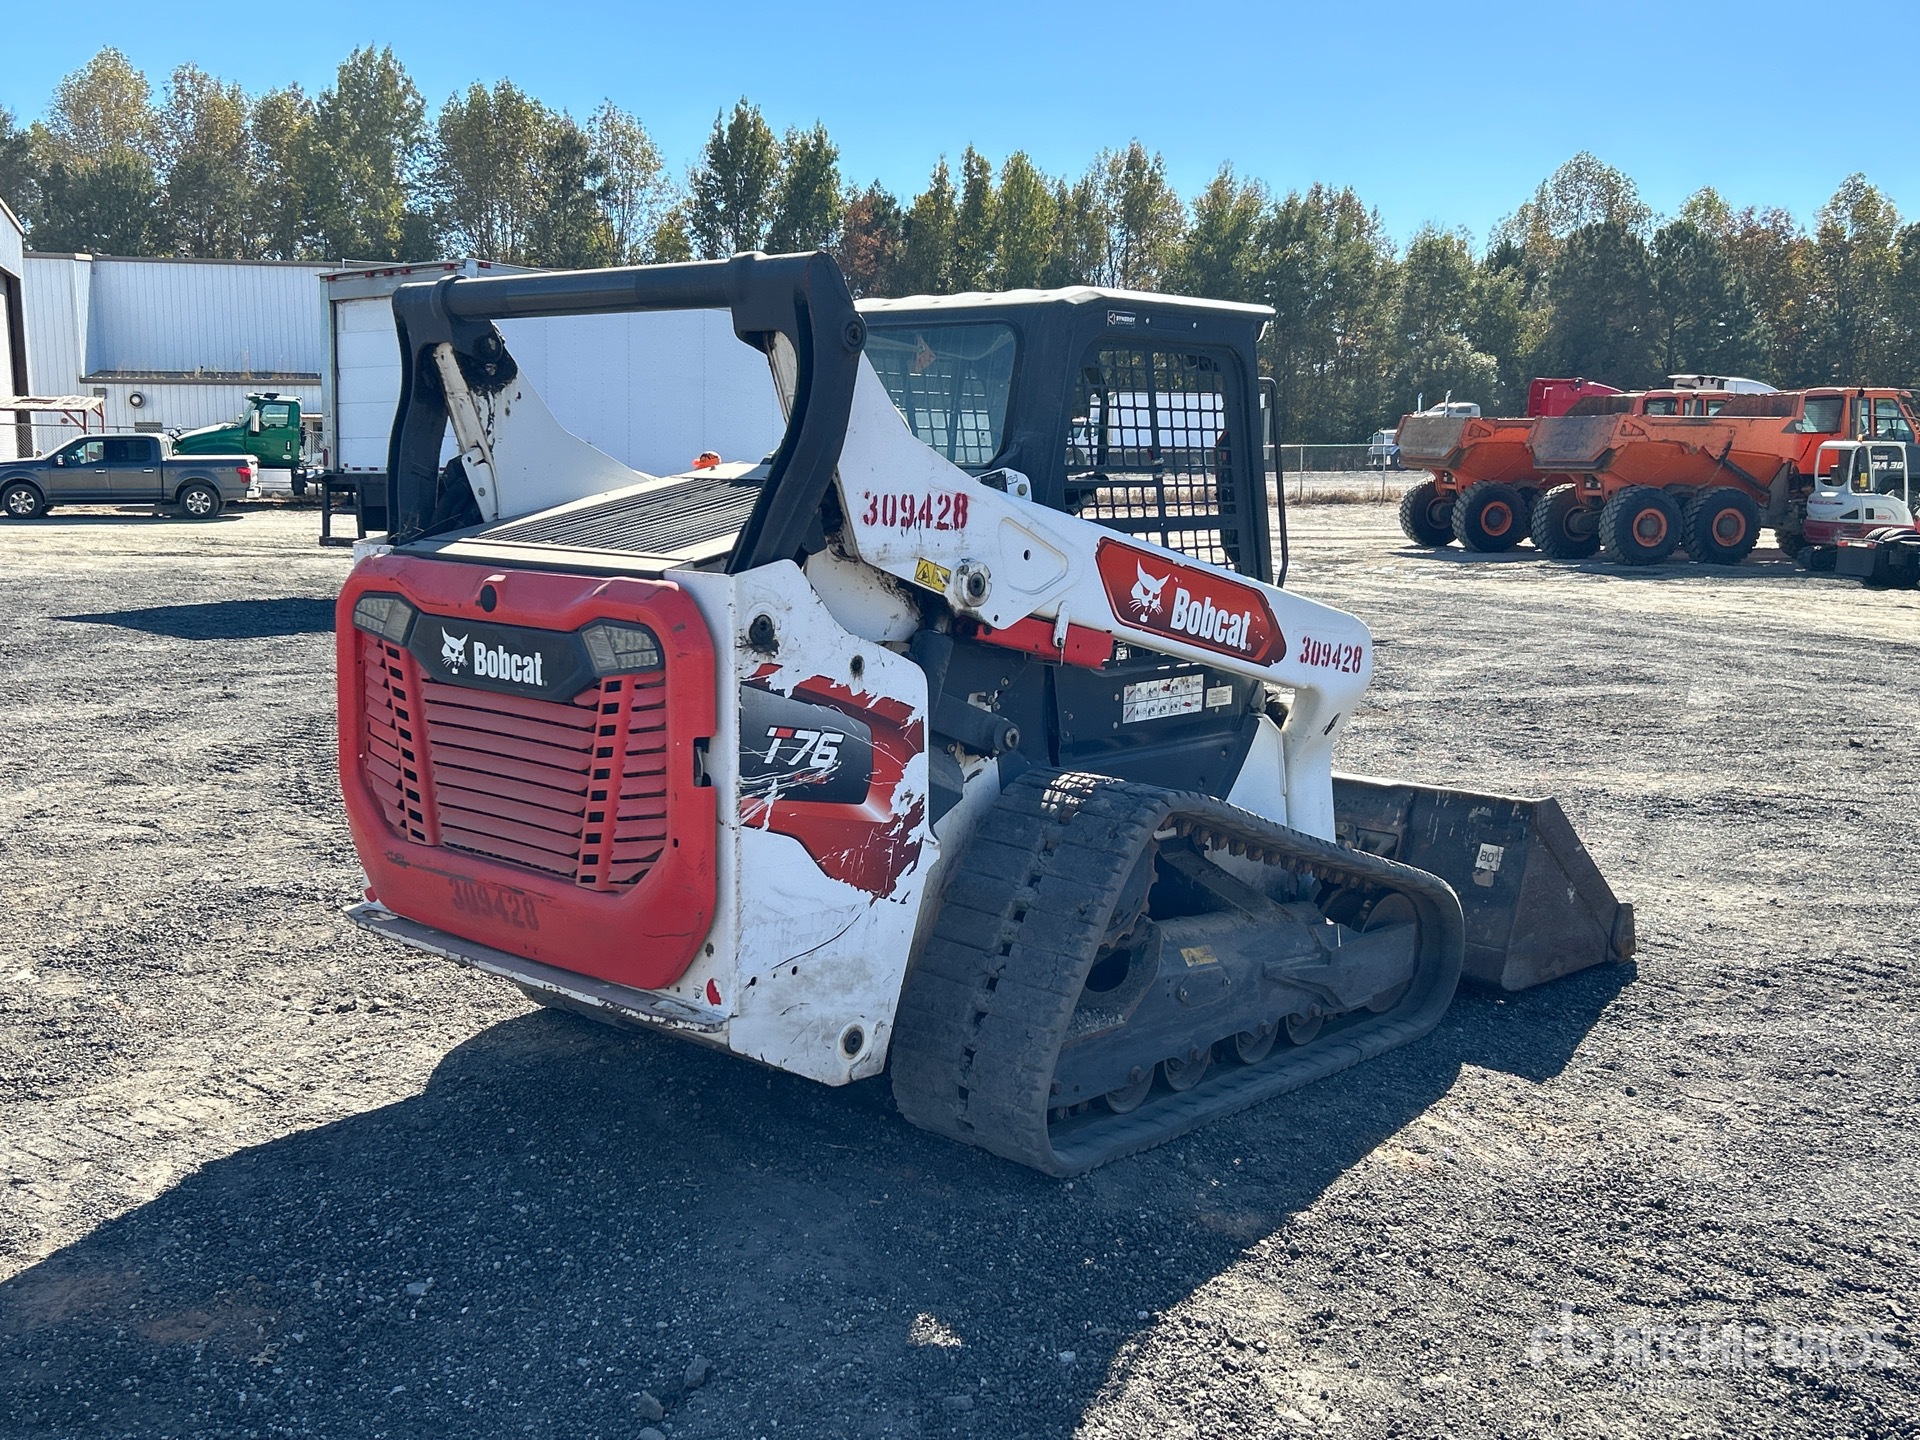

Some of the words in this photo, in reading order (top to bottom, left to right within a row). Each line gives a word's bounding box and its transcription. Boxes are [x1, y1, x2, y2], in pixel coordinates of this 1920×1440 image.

[863, 490, 968, 530] 309428
[1170, 587, 1251, 650] Bobcat
[473, 641, 543, 686] Bobcat
[1299, 635, 1363, 674] 309428
[763, 726, 845, 768] T76
[449, 876, 540, 932] 309428
